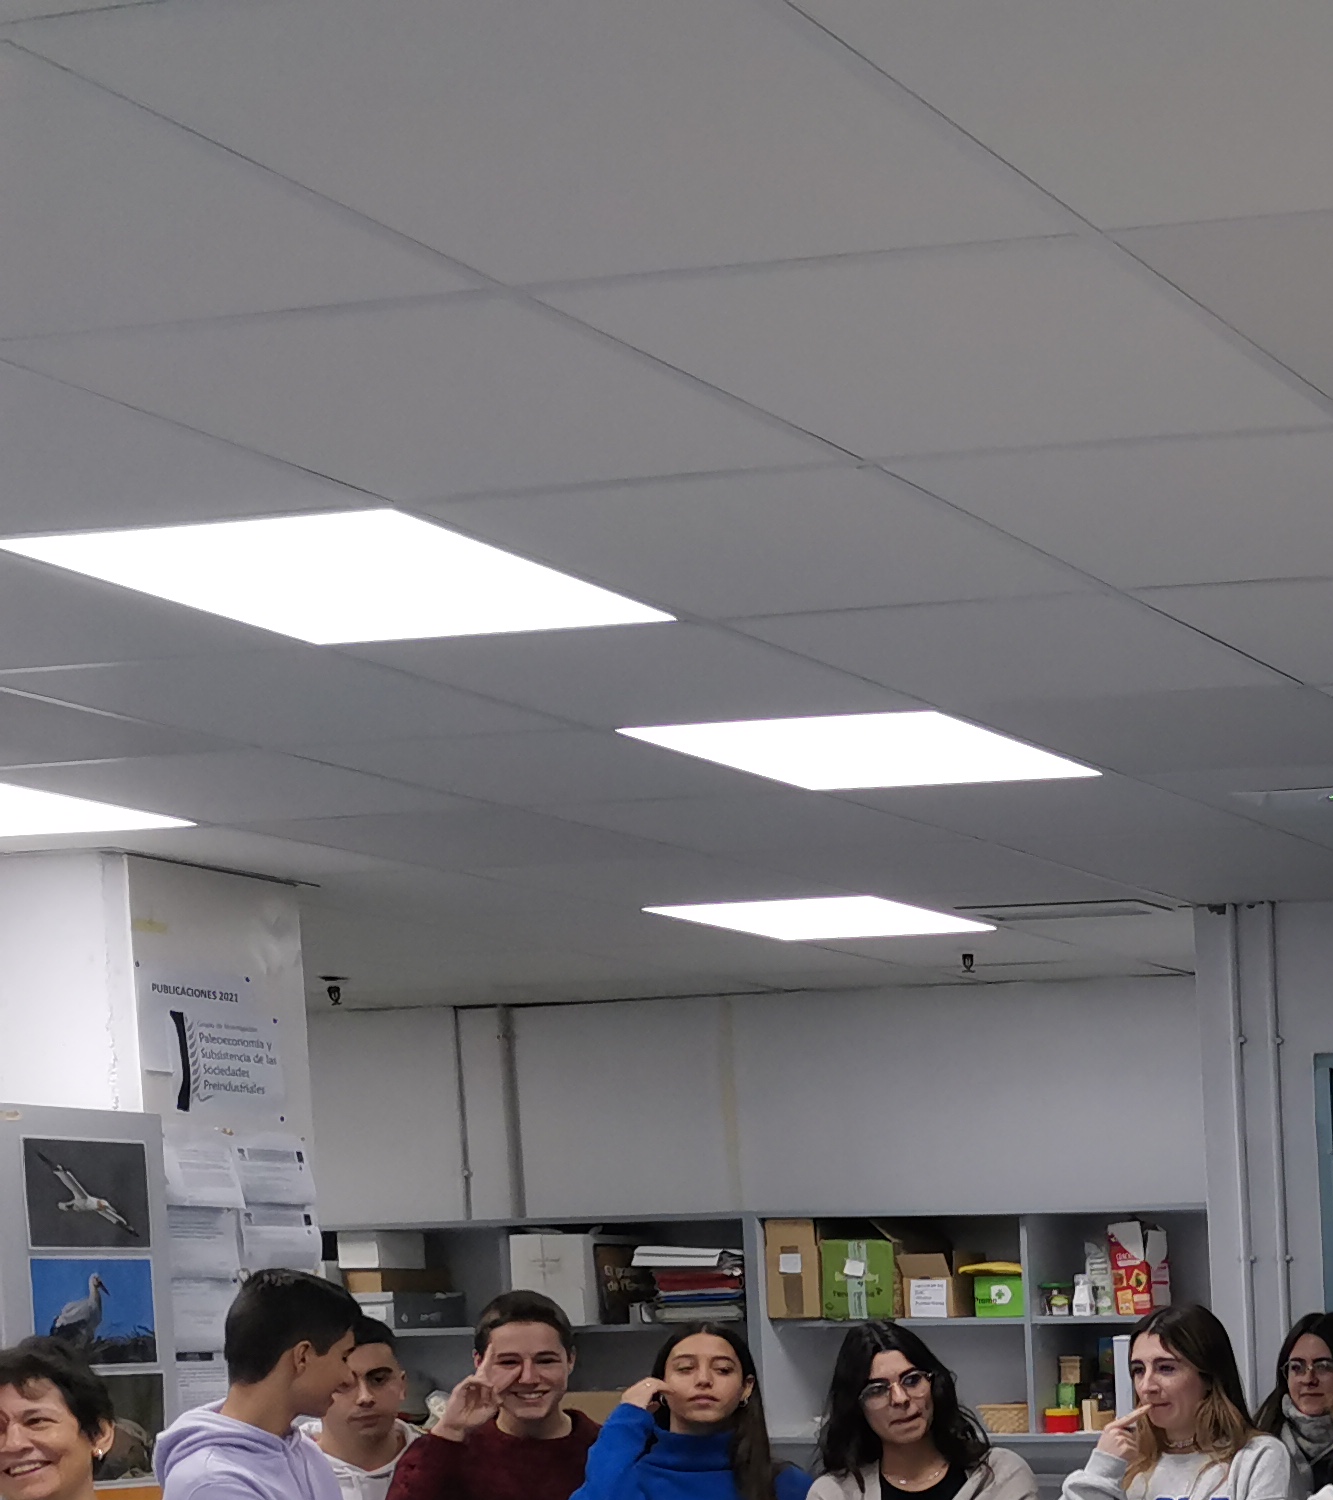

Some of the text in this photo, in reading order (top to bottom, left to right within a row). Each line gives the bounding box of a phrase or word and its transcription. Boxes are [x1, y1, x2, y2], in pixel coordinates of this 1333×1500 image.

[151, 983, 238, 1002] PUBLICACIONES 2021
[202, 1063, 250, 1078] Sociedades
